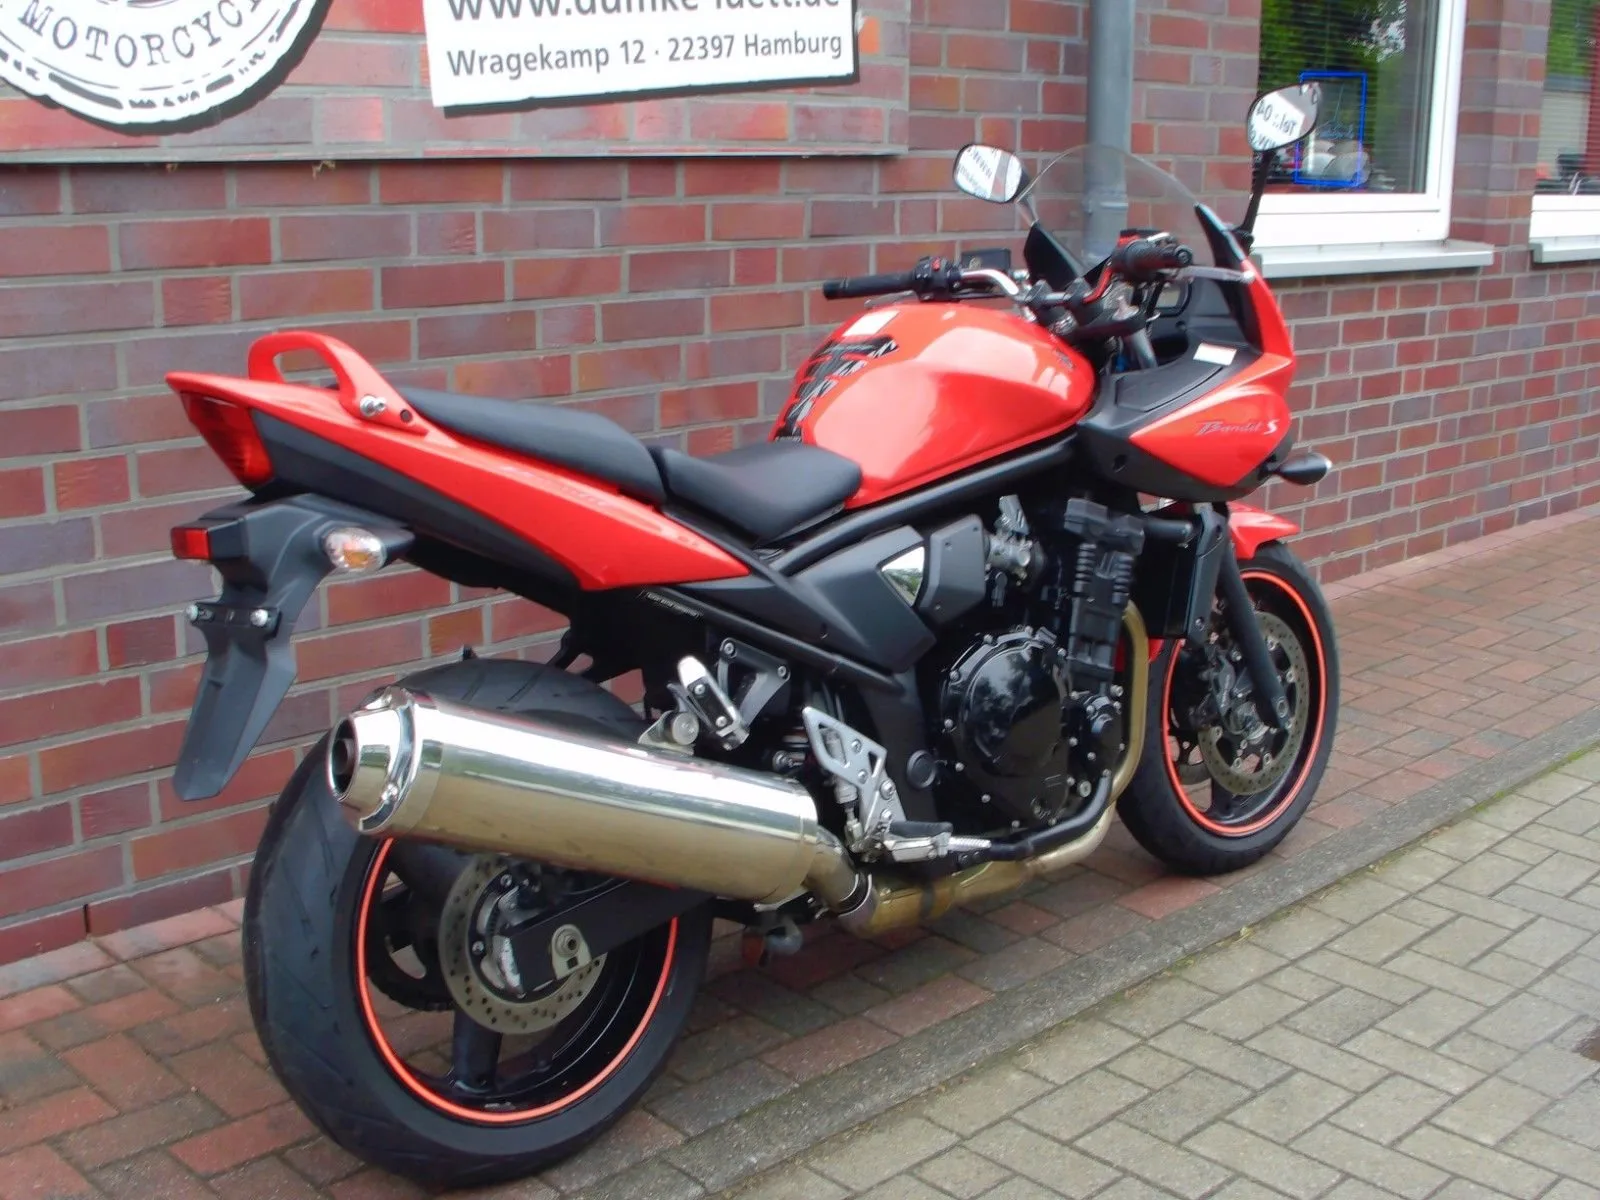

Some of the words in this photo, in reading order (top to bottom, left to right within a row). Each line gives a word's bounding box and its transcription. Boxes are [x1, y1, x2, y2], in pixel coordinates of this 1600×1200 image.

[17, 0, 260, 67] MOTORCYC
[447, 44, 610, 80] Wragekamp
[620, 40, 646, 65] 12
[667, 35, 735, 61] 22397
[744, 31, 842, 59] Hamburg
[1195, 420, 1261, 435] Bandit
[1264, 419, 1279, 435] S
